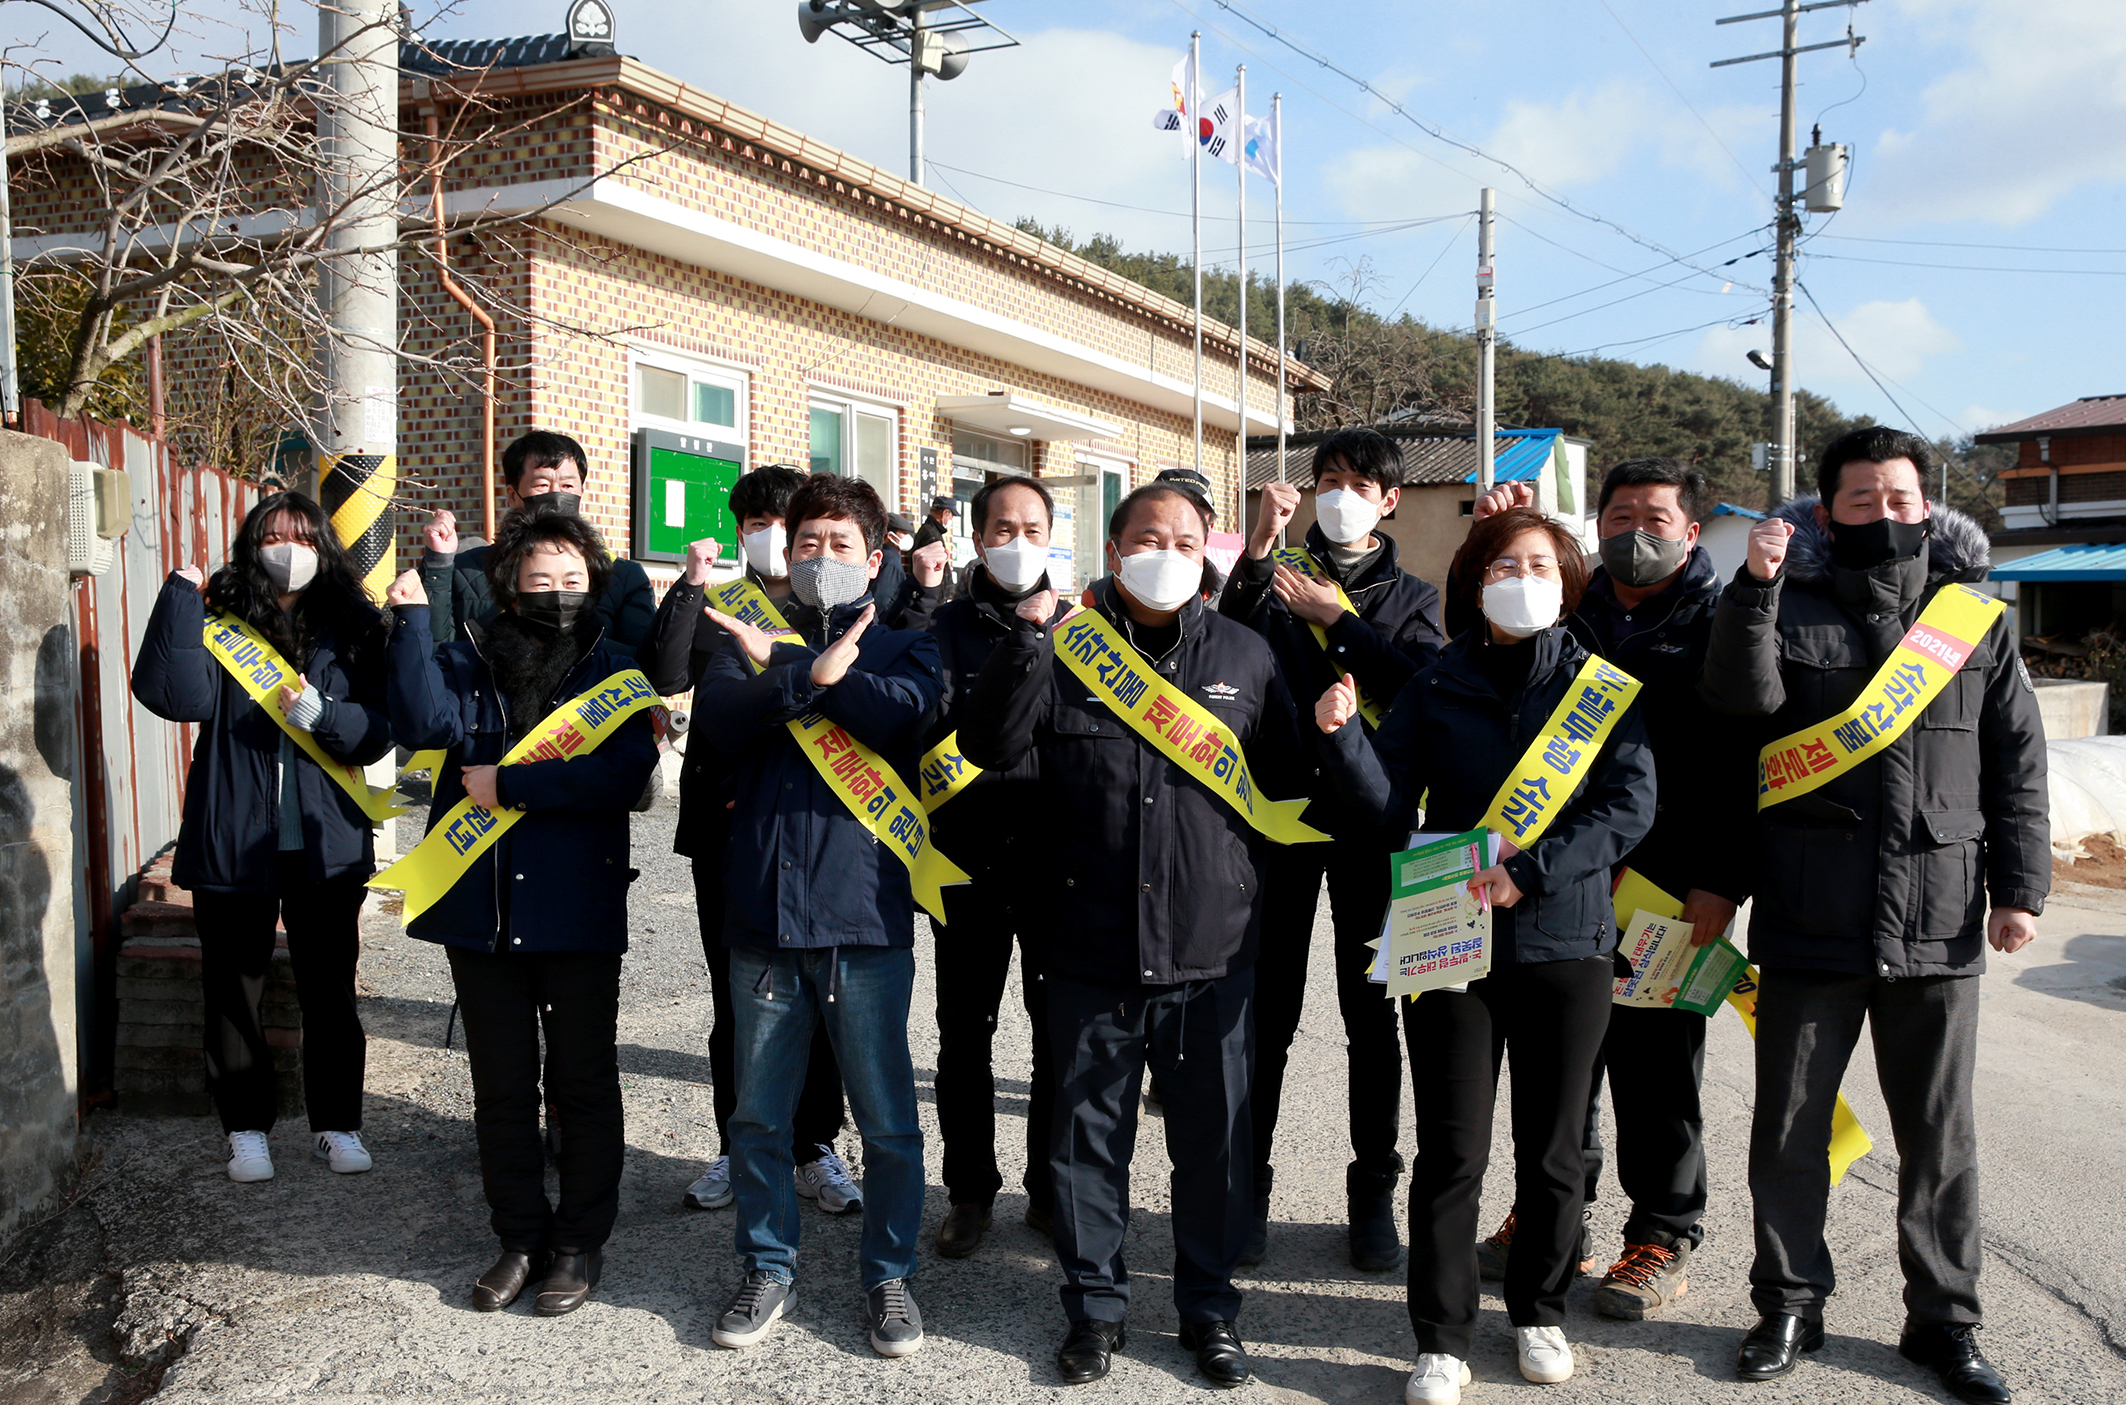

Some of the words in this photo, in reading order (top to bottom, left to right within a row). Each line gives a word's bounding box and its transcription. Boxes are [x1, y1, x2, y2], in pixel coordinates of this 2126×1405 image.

[1909, 629, 1962, 668] 2021년
[1063, 622, 1149, 709] 소각산불
[1142, 694, 1239, 785] 제로화의
[1542, 663, 1629, 775] 논·밭두렁
[1833, 663, 1927, 754] 소각산불
[813, 725, 897, 821] 제로화의
[888, 805, 925, 860] 원년
[921, 753, 965, 796] 소각
[1500, 776, 1551, 838] 소각
[1400, 946, 1447, 966] 상식입니다!
[1400, 960, 1437, 977] 태우기는
[1451, 937, 1483, 954] 잘못된
